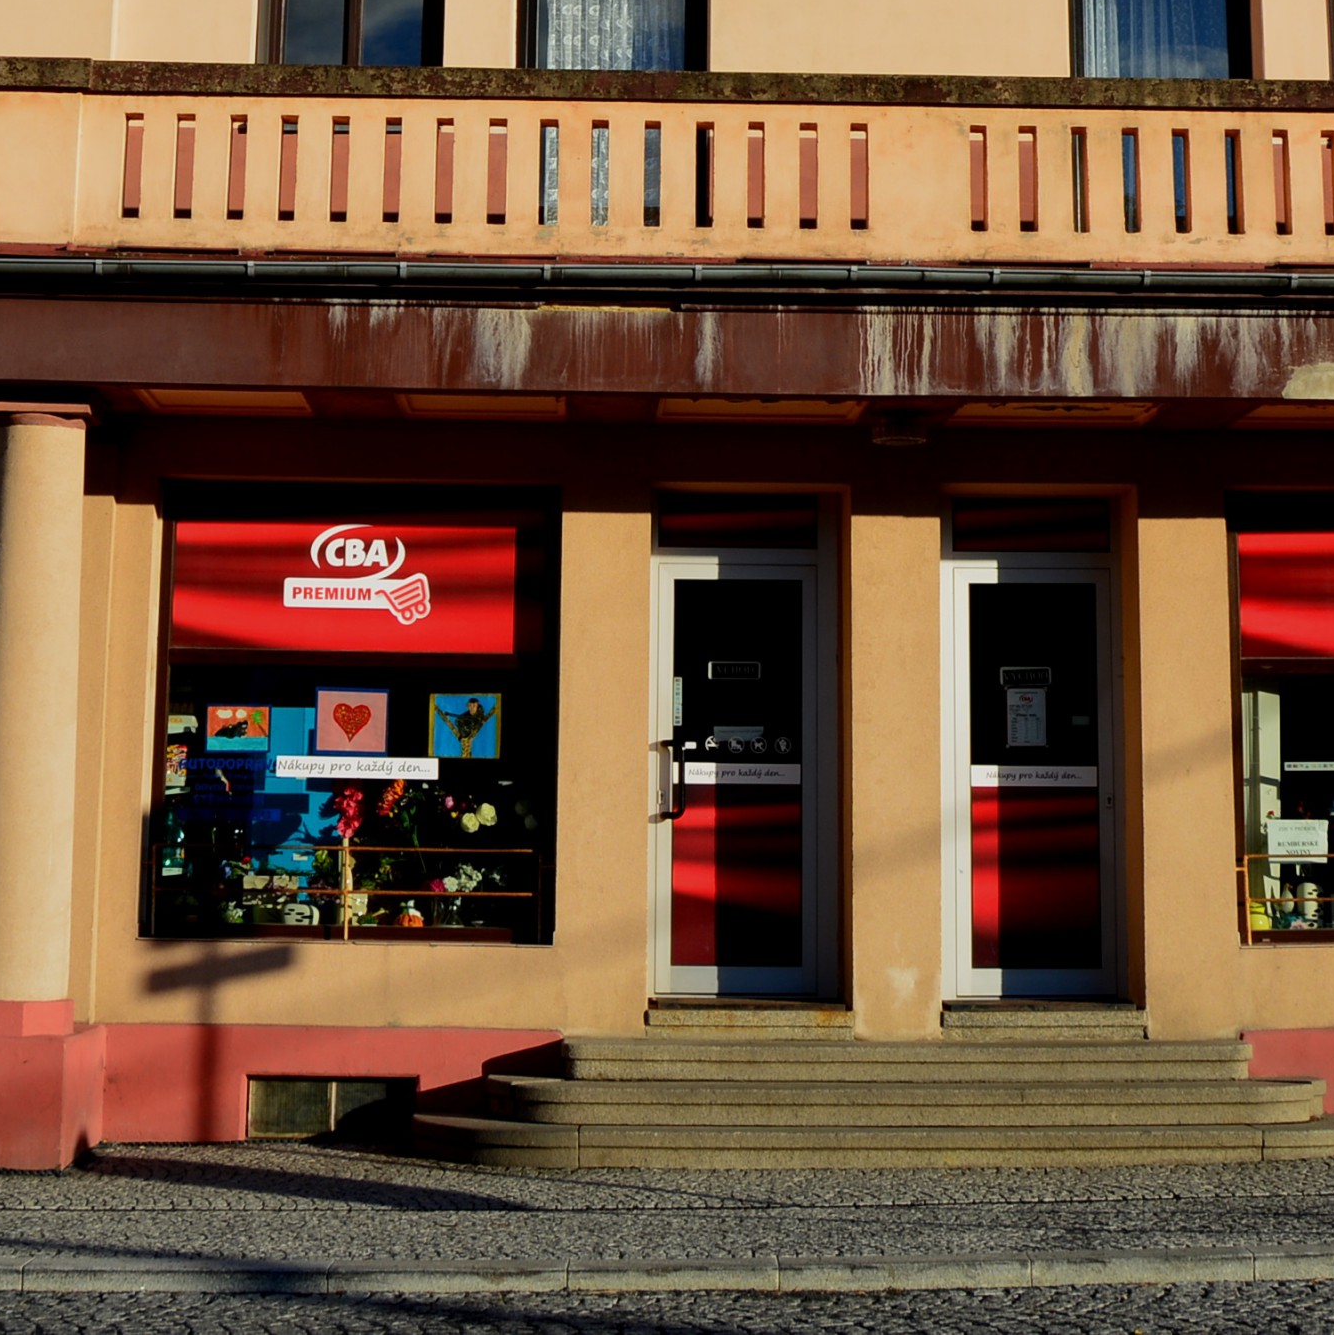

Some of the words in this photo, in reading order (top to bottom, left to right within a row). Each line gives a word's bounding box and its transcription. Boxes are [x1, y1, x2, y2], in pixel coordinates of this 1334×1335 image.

[324, 537, 390, 568] CBA
[292, 586, 372, 601] PREMIUM
[178, 757, 278, 771] AUTODOPRAV
[277, 760, 325, 775] Nákupy
[329, 763, 352, 775] pro
[356, 761, 393, 775] každý
[397, 761, 431, 773] den...
